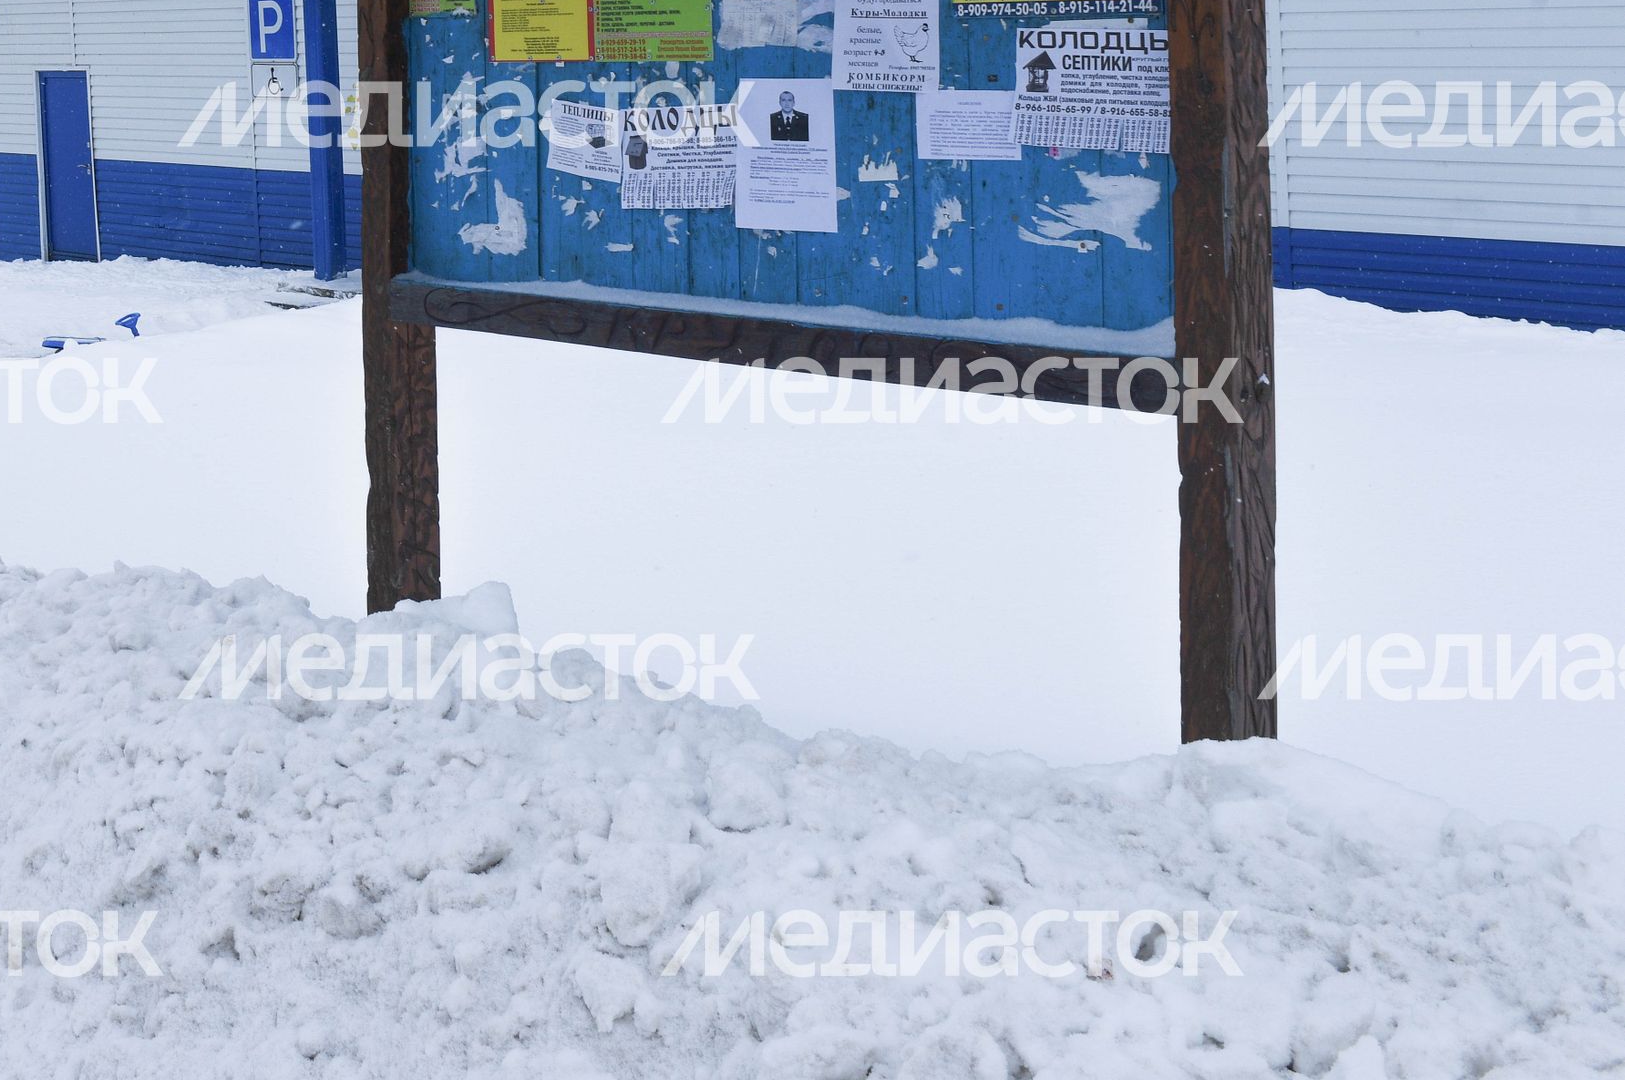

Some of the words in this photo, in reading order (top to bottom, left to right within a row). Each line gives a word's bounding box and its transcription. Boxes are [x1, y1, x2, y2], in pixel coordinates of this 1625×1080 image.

[851, 8, 927, 18] Куры-Молодки
[957, 3, 1047, 17] 8-909-974-50-05
[1058, 0, 1152, 14] 8-915-114-21-44
[849, 38, 882, 46] красные
[1062, 55, 1132, 72] СЕПТИКИ
[848, 72, 925, 83] КОМБИКОРМ
[852, 83, 874, 91] ЦЕНЫ
[1018, 94, 1041, 102] Кольца
[561, 103, 614, 122] ТЕПЛИЦЫ
[1014, 103, 1092, 114] 8-966-105-65-99
[624, 105, 737, 137] КОЛОДЦЫ
